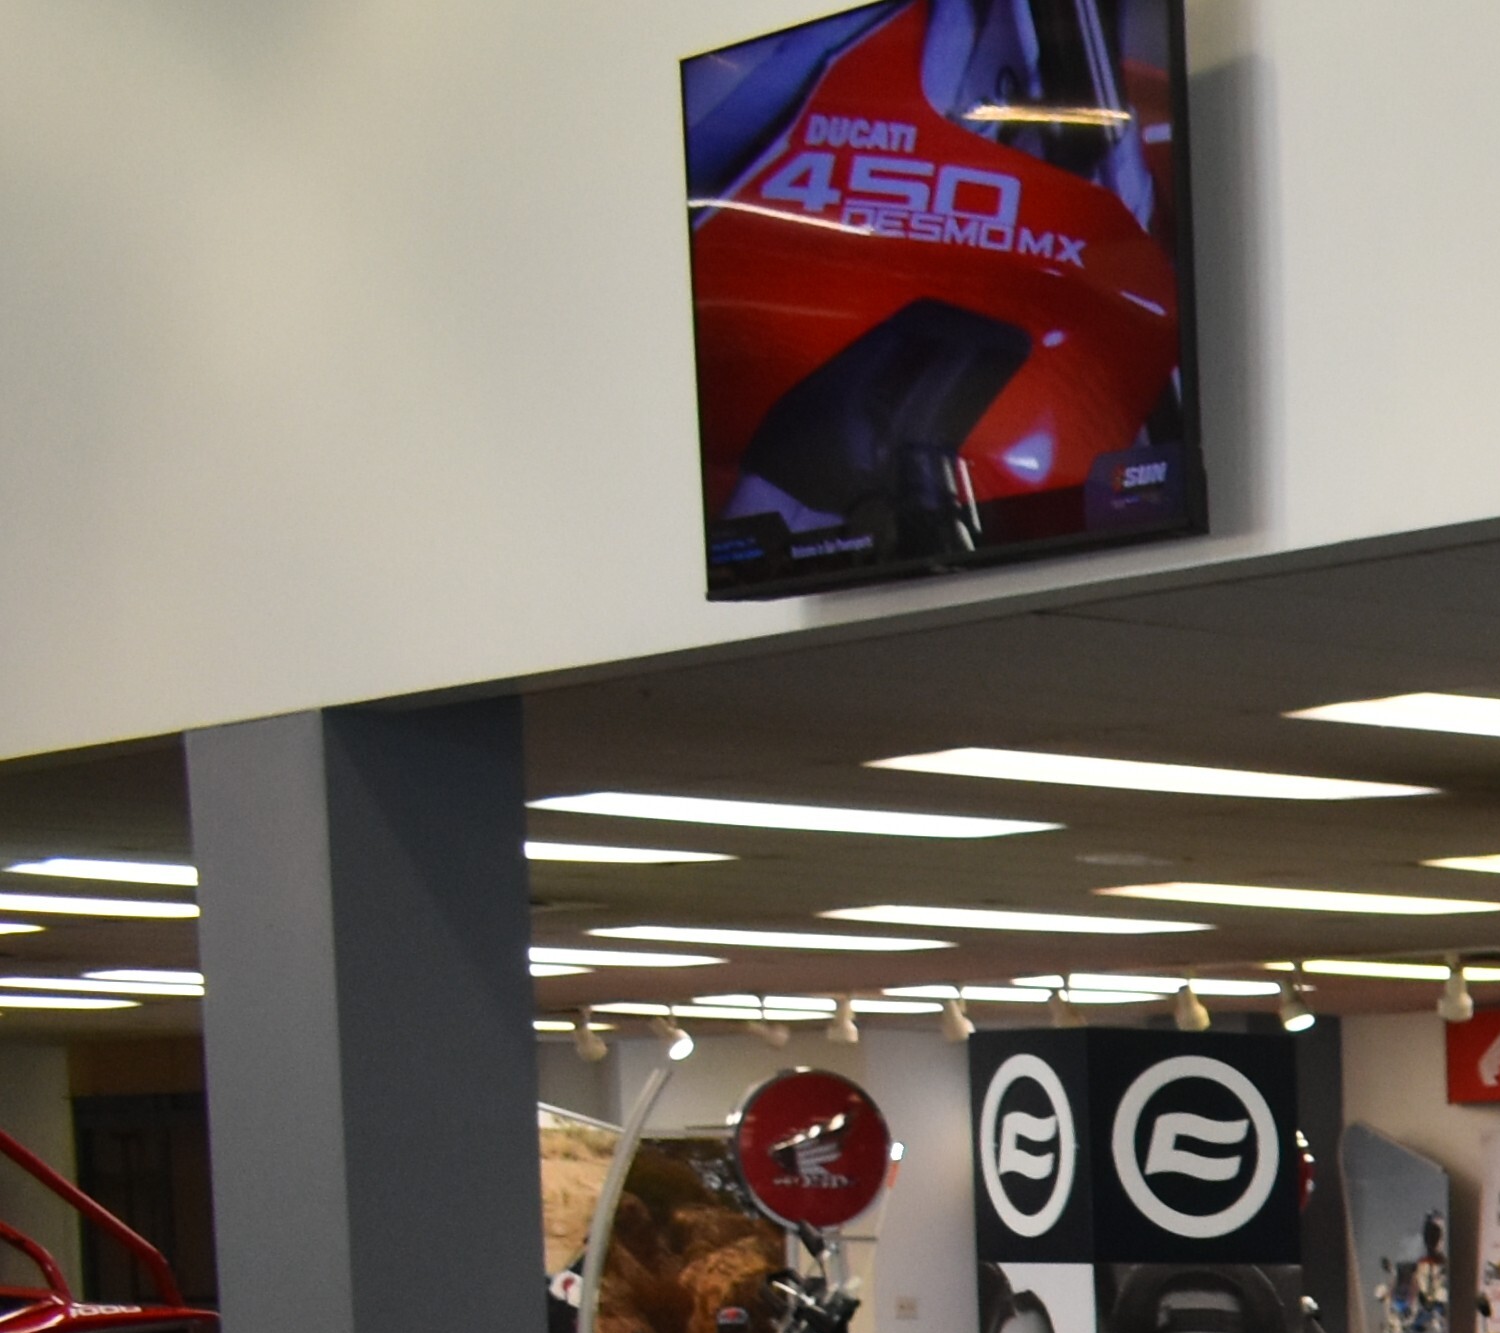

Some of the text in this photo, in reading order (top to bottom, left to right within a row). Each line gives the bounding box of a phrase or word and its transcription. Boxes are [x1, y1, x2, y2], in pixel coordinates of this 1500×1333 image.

[804, 114, 917, 153] DUCATI
[761, 152, 1021, 226] 450
[841, 199, 1085, 268] DESMO MX
[1124, 461, 1166, 487] SUN
